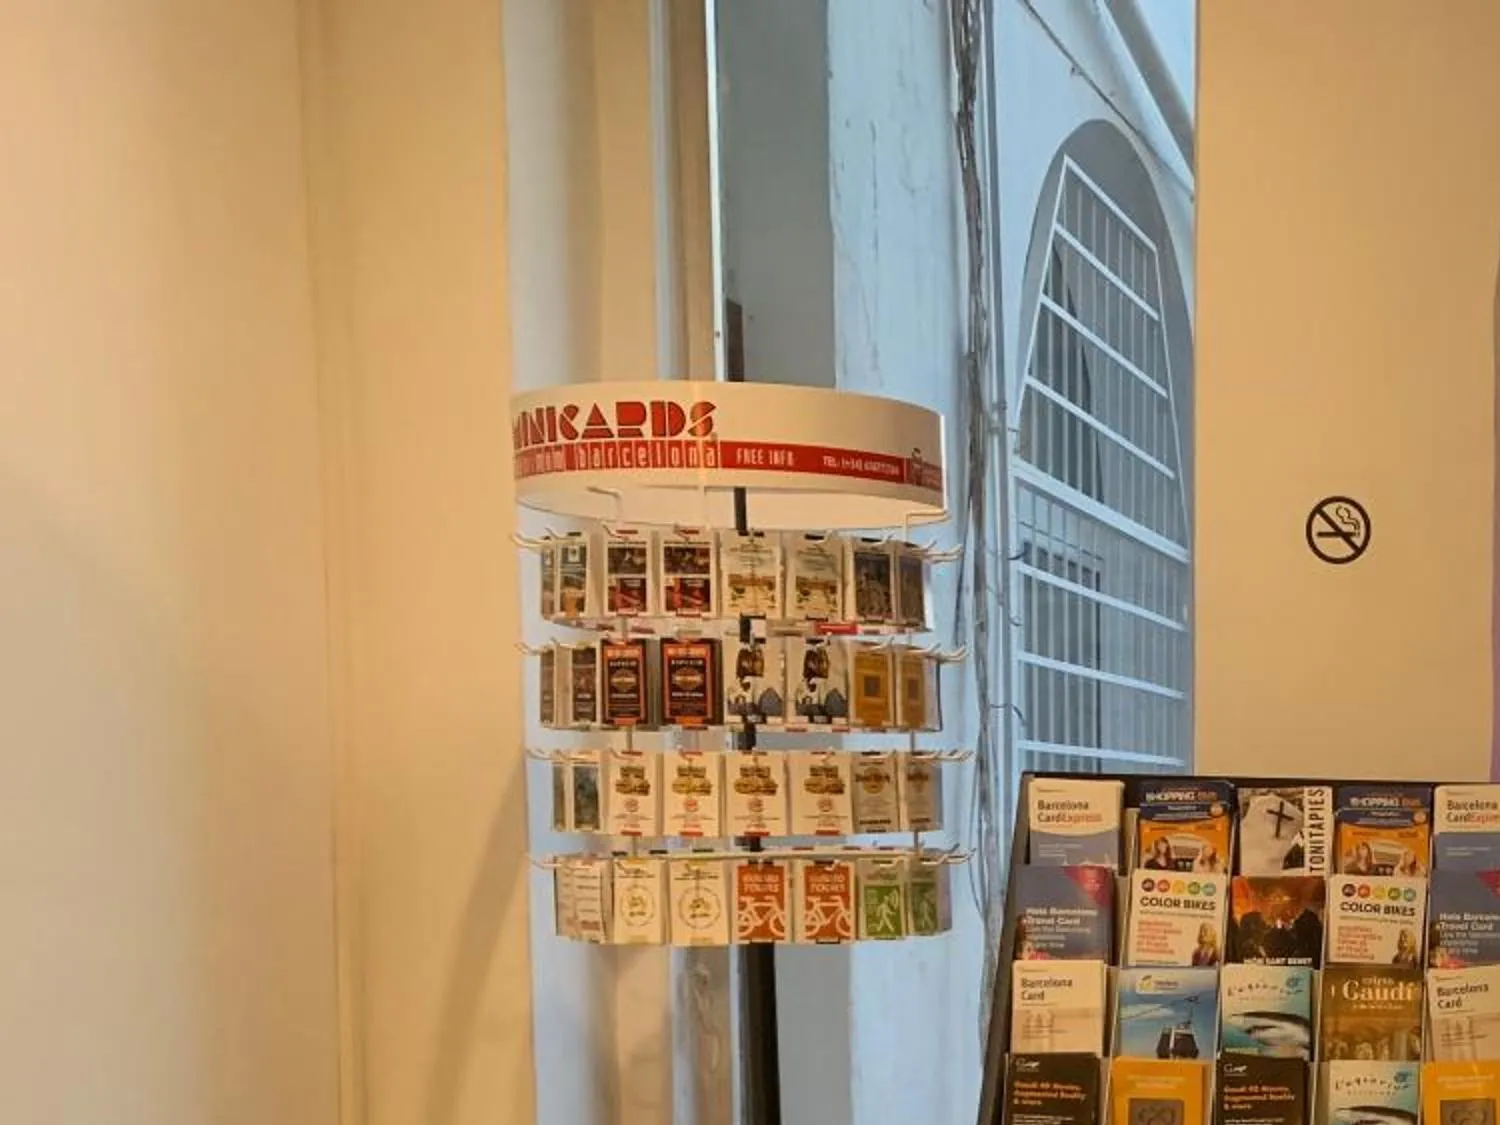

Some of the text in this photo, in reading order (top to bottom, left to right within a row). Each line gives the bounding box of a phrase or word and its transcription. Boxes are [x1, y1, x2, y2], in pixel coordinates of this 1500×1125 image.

[579, 443, 718, 470] barcelona
[735, 448, 764, 465] FREE
[1446, 799, 1499, 811] Barcelona
[1139, 896, 1216, 911] COLOR BIKES
[1339, 902, 1416, 917] COLOR BIKES
[1020, 977, 1073, 988] Barcelona
[1436, 982, 1490, 997] Barcelona
[1020, 989, 1046, 1001] Card
[1436, 998, 1463, 1010] Card
